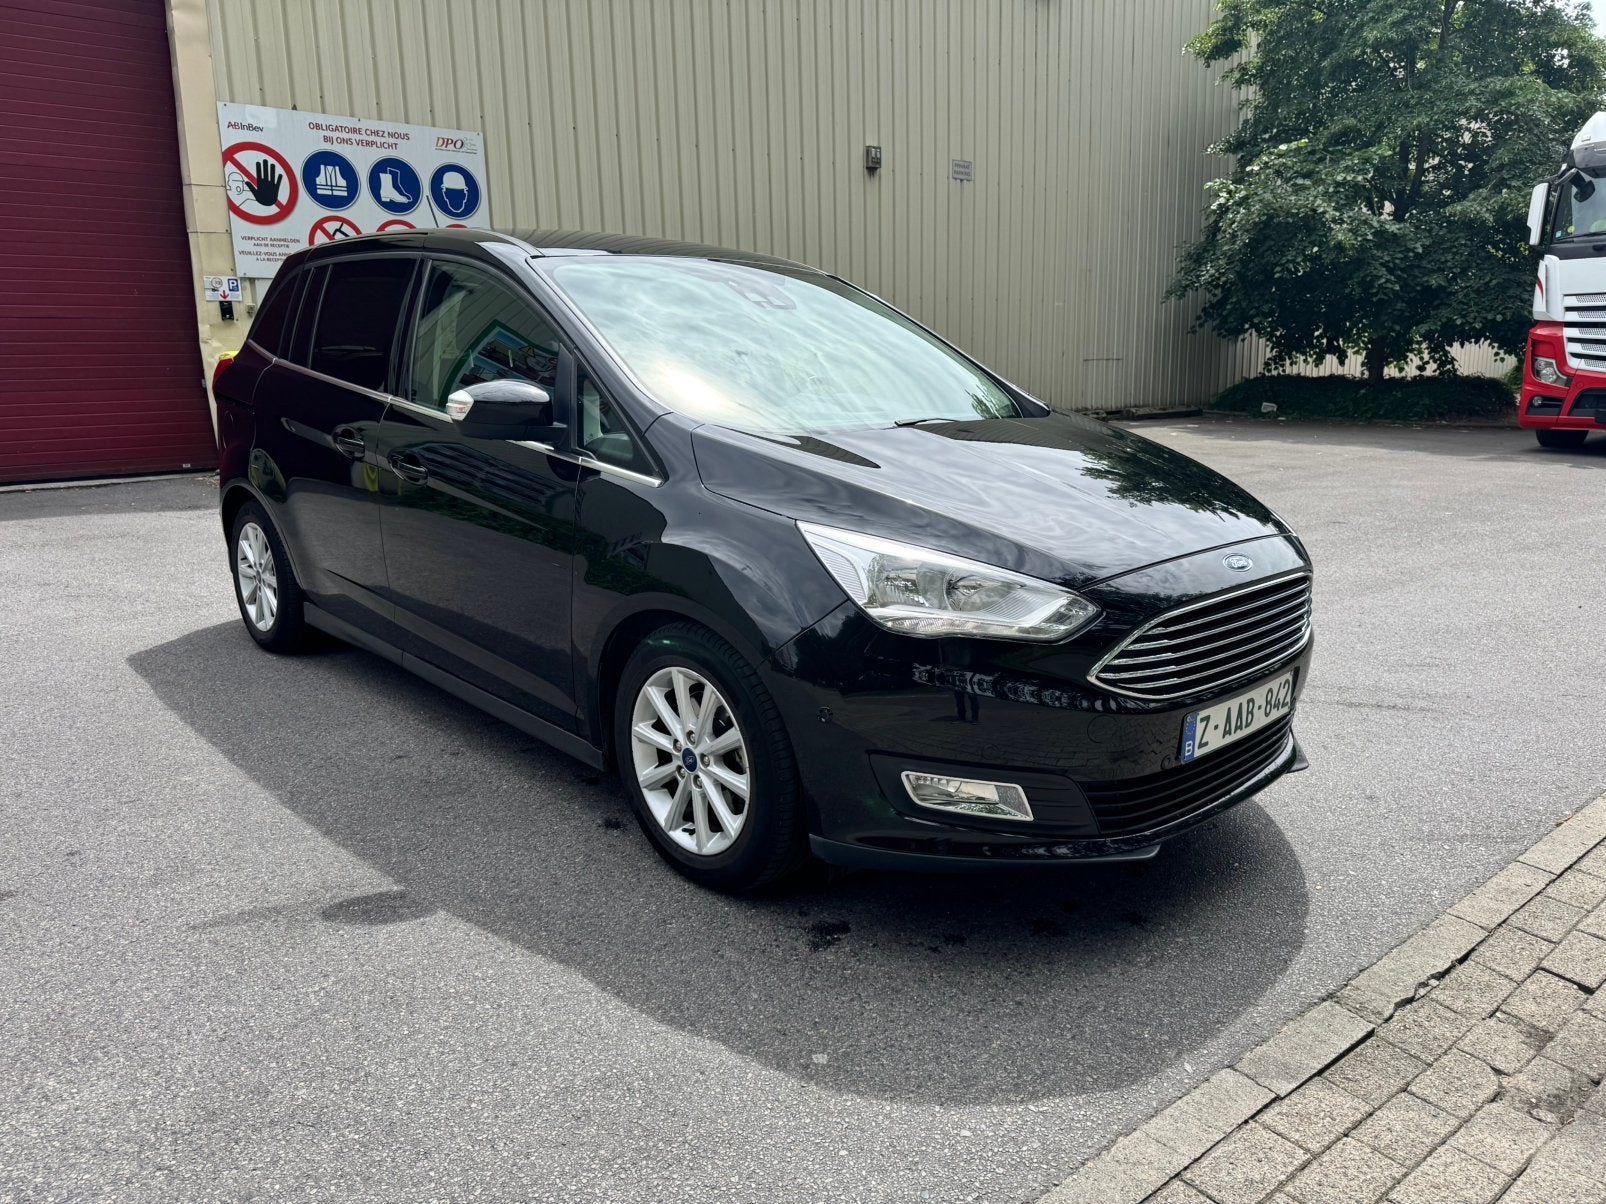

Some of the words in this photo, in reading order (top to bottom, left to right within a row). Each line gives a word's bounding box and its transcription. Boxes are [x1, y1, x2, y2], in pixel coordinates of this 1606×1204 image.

[308, 122, 363, 136] OBLIGATOIRE
[365, 128, 386, 139] CHEZ
[387, 131, 411, 141] NOUS
[323, 135, 334, 145] BIJ
[336, 137, 353, 146] ONS
[354, 139, 399, 150] VERPLICHT
[435, 137, 464, 150] DPO
[229, 280, 238, 290] P
[1184, 740, 1194, 756] B
[1197, 678, 1291, 750] Z-AAB-842
